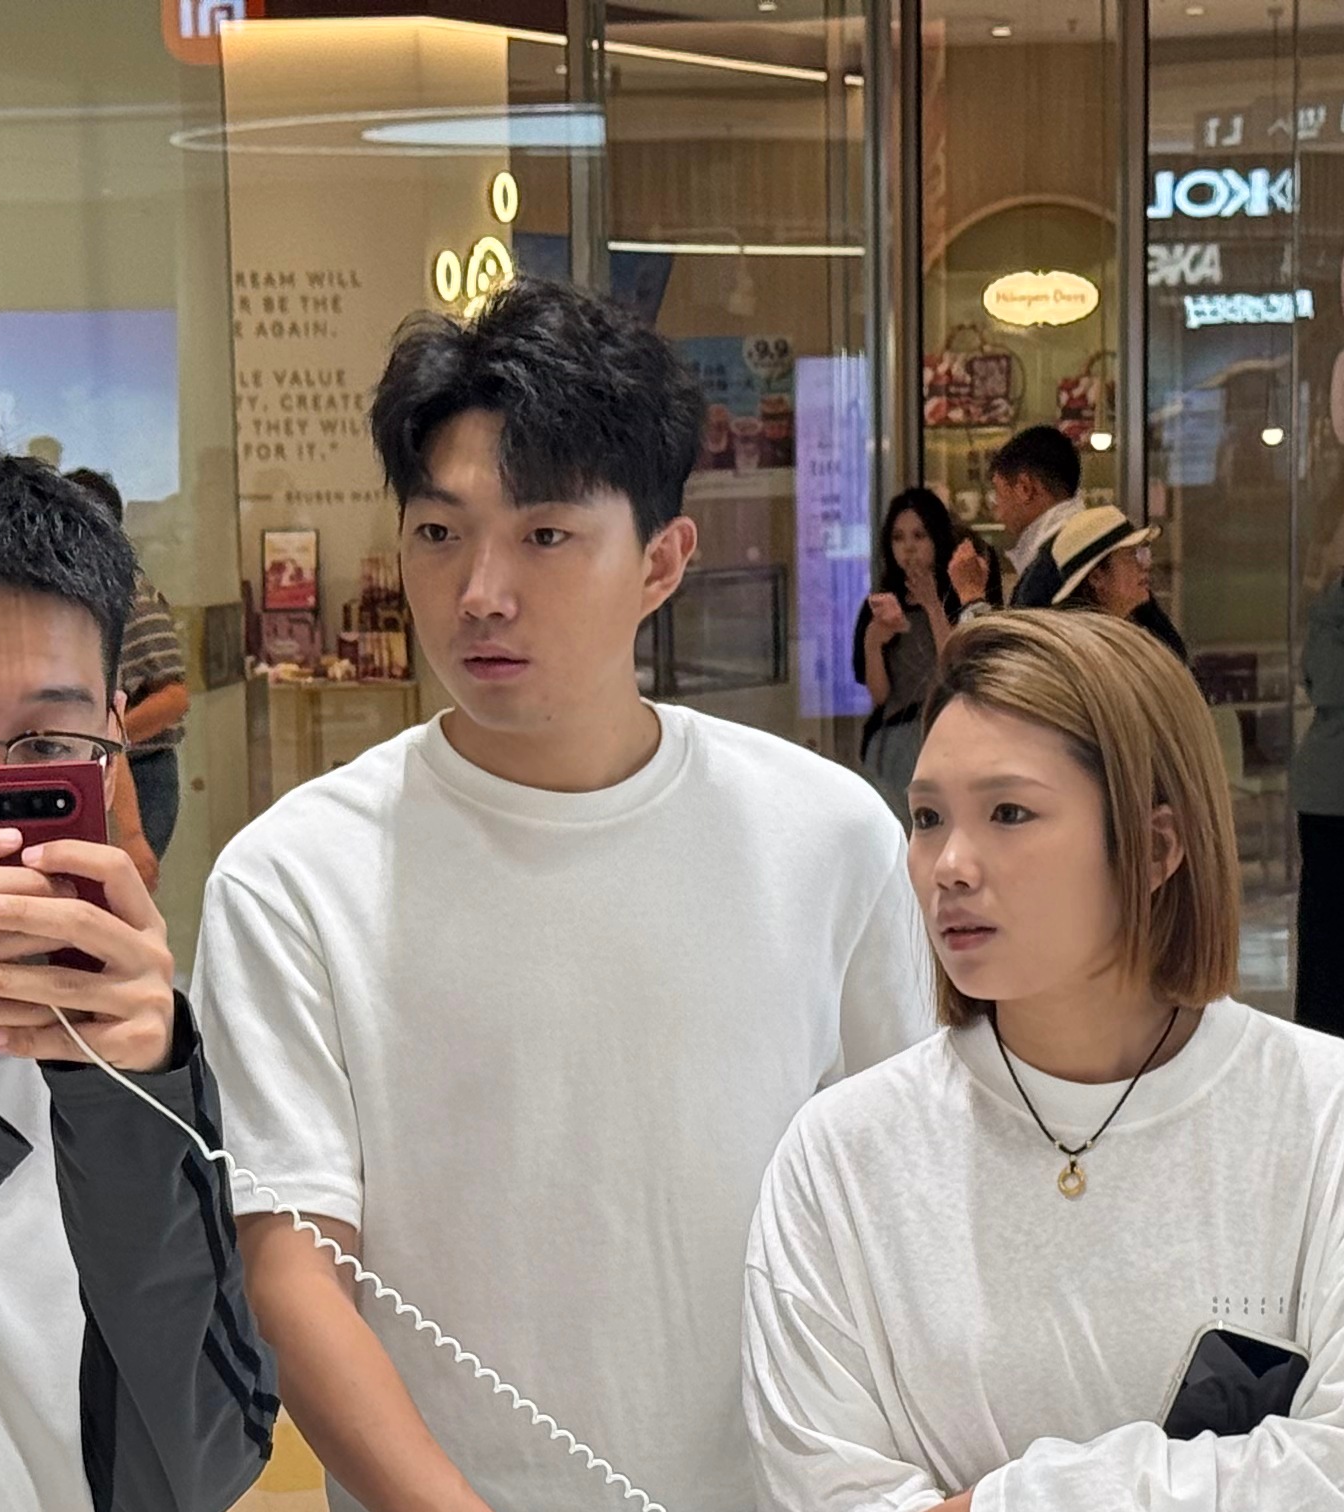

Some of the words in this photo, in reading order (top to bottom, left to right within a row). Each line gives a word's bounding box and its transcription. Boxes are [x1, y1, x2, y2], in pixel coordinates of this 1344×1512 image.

[307, 270, 362, 289] WILL
[262, 296, 288, 313] BE
[300, 294, 342, 314] THE
[255, 320, 338, 339] AGAIN.
[273, 369, 346, 387] VALUE
[253, 419, 308, 436] THEY
[243, 442, 286, 460] FOR
